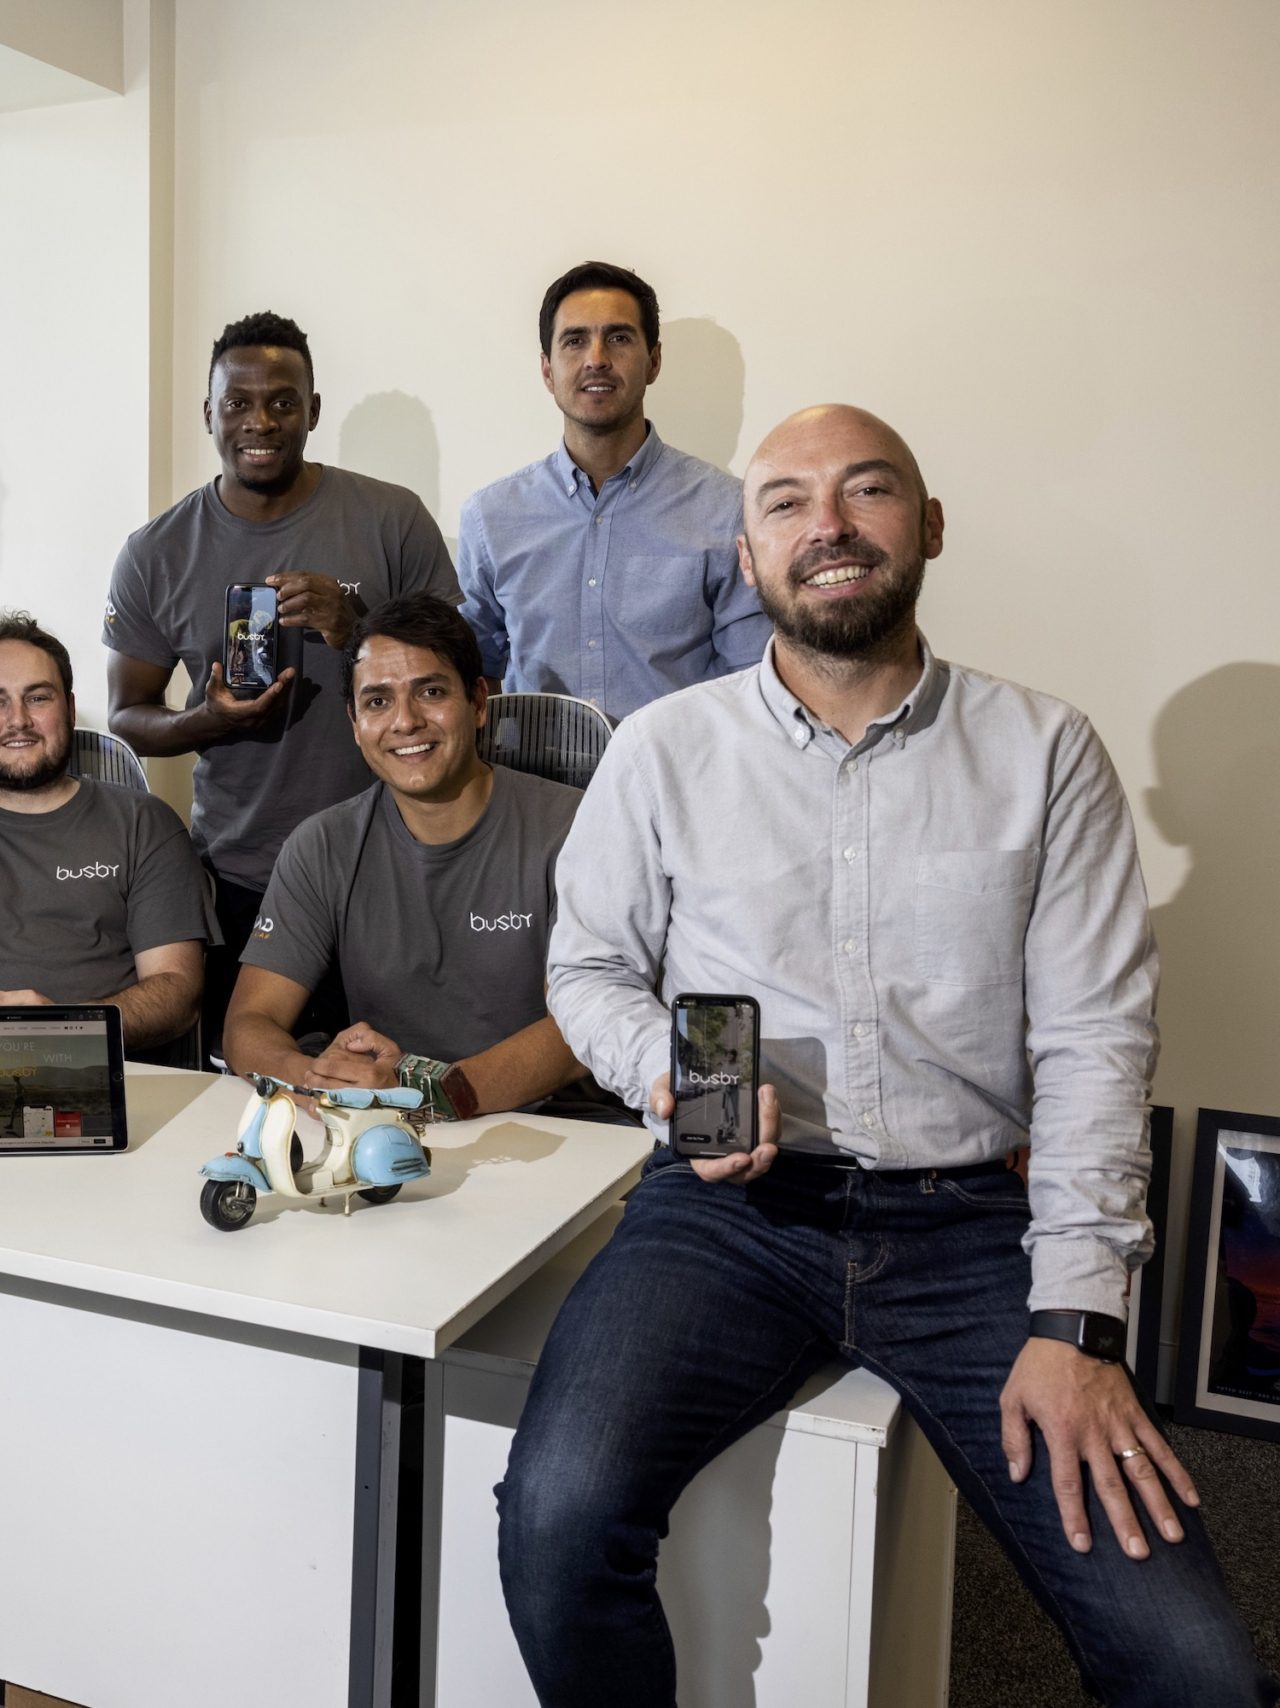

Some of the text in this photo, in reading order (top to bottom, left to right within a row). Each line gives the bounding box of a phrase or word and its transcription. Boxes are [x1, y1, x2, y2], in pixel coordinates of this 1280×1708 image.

[56, 861, 120, 880] busby
[470, 911, 533, 932] busby
[43, 1053, 72, 1063] WITH
[688, 1069, 740, 1085] busby
